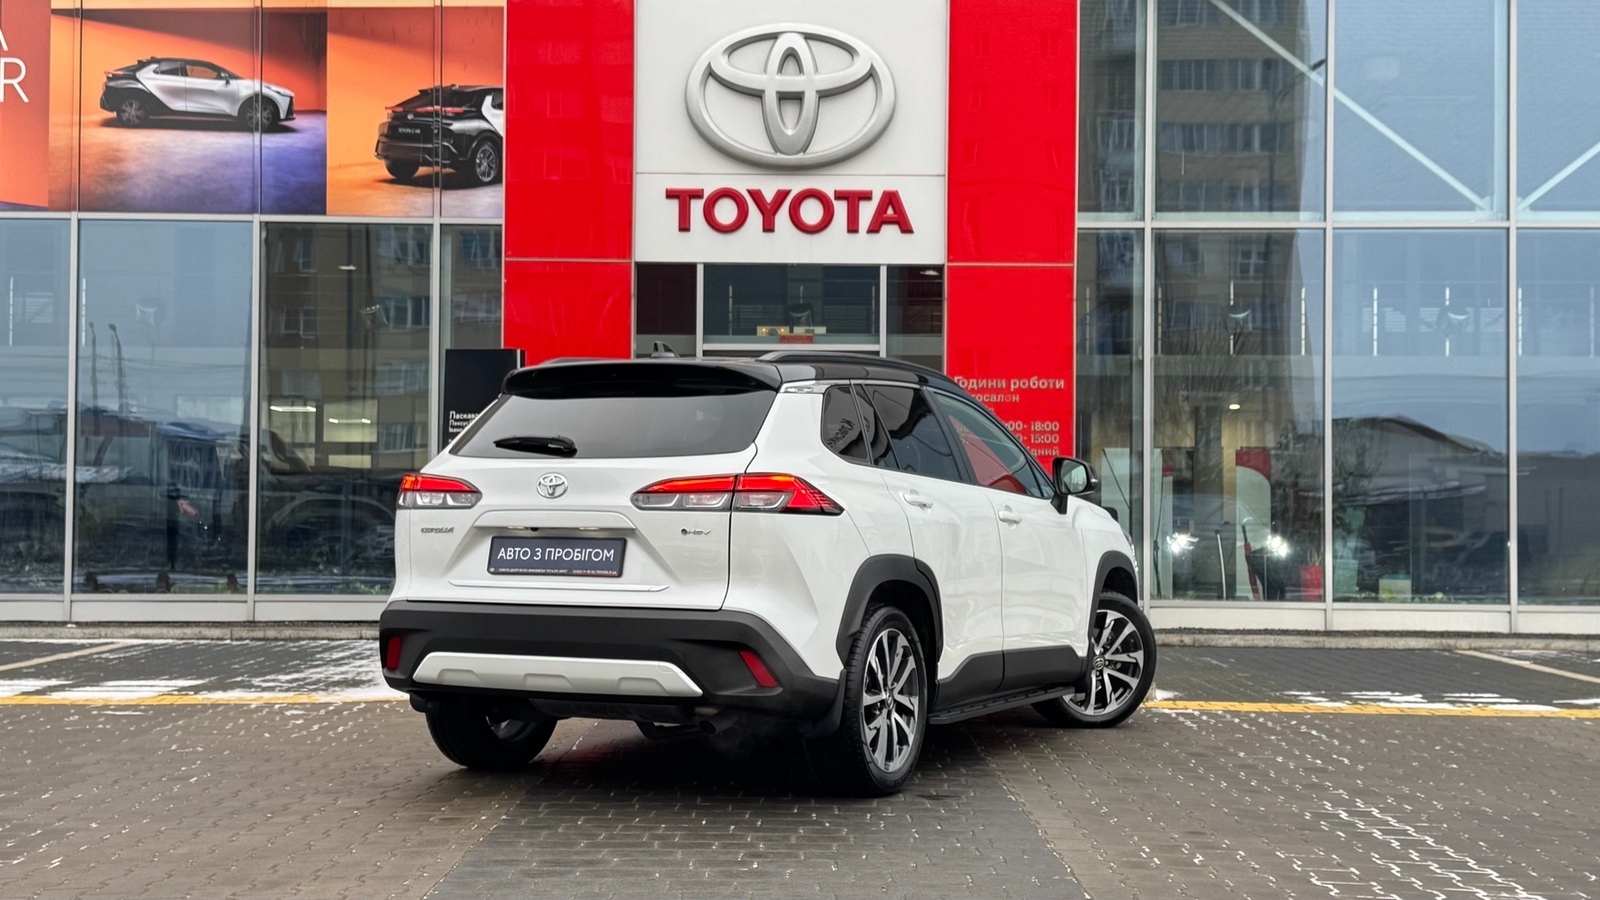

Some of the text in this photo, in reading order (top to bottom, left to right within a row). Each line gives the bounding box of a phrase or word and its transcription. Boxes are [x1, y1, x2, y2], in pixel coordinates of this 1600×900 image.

[665, 187, 914, 234] TOYOTA
[954, 376, 1065, 391] Години роботи
[1031, 421, 1060, 431] 18:00
[1031, 434, 1060, 443] 15:00
[497, 547, 615, 562] АВТО З ПРОБІГОМ
